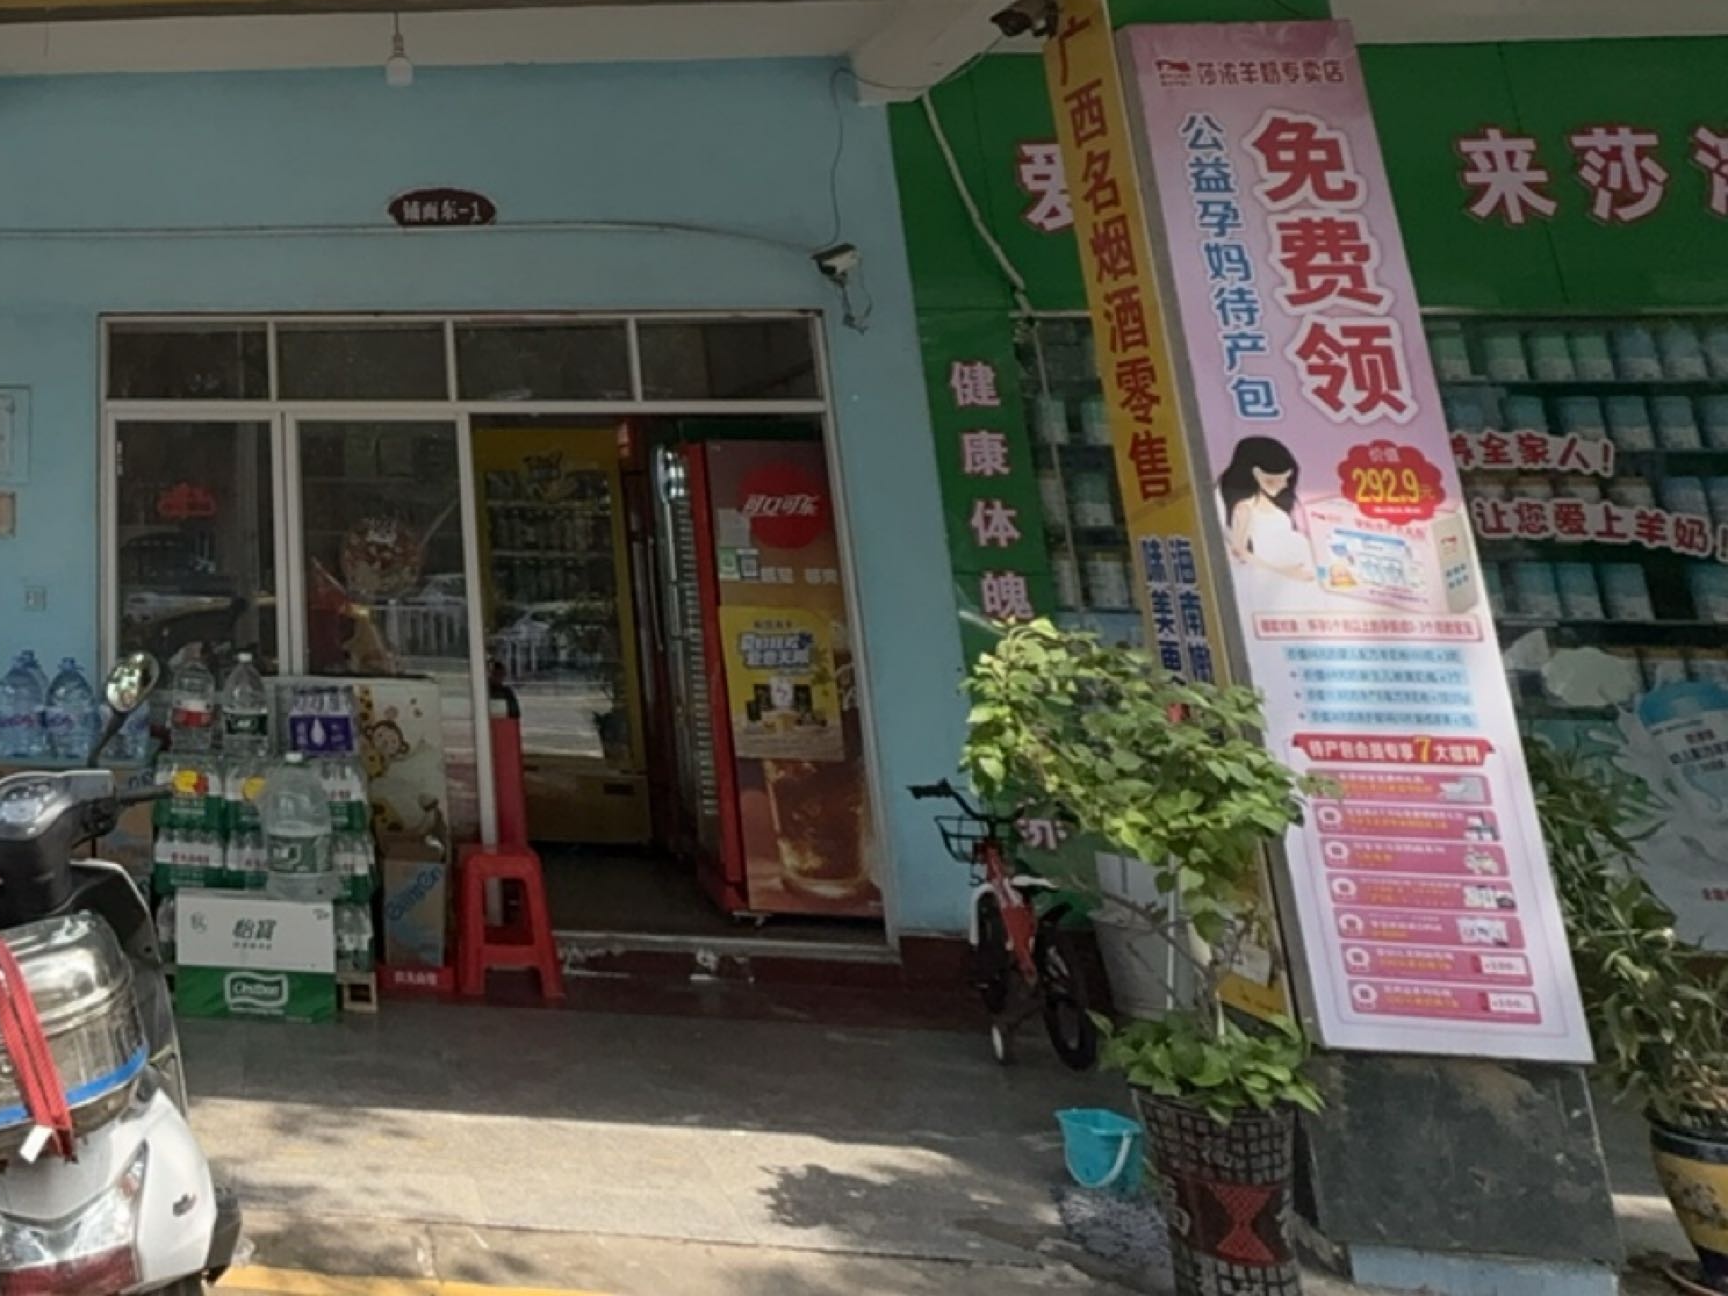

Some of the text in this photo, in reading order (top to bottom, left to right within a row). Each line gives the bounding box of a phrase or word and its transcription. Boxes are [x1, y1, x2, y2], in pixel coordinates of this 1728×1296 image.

[1051, 13, 1171, 503] 广西名烟酒零售
[1180, 113, 1280, 420] 公益孕妈待产包
[1252, 115, 1408, 415] 免费领
